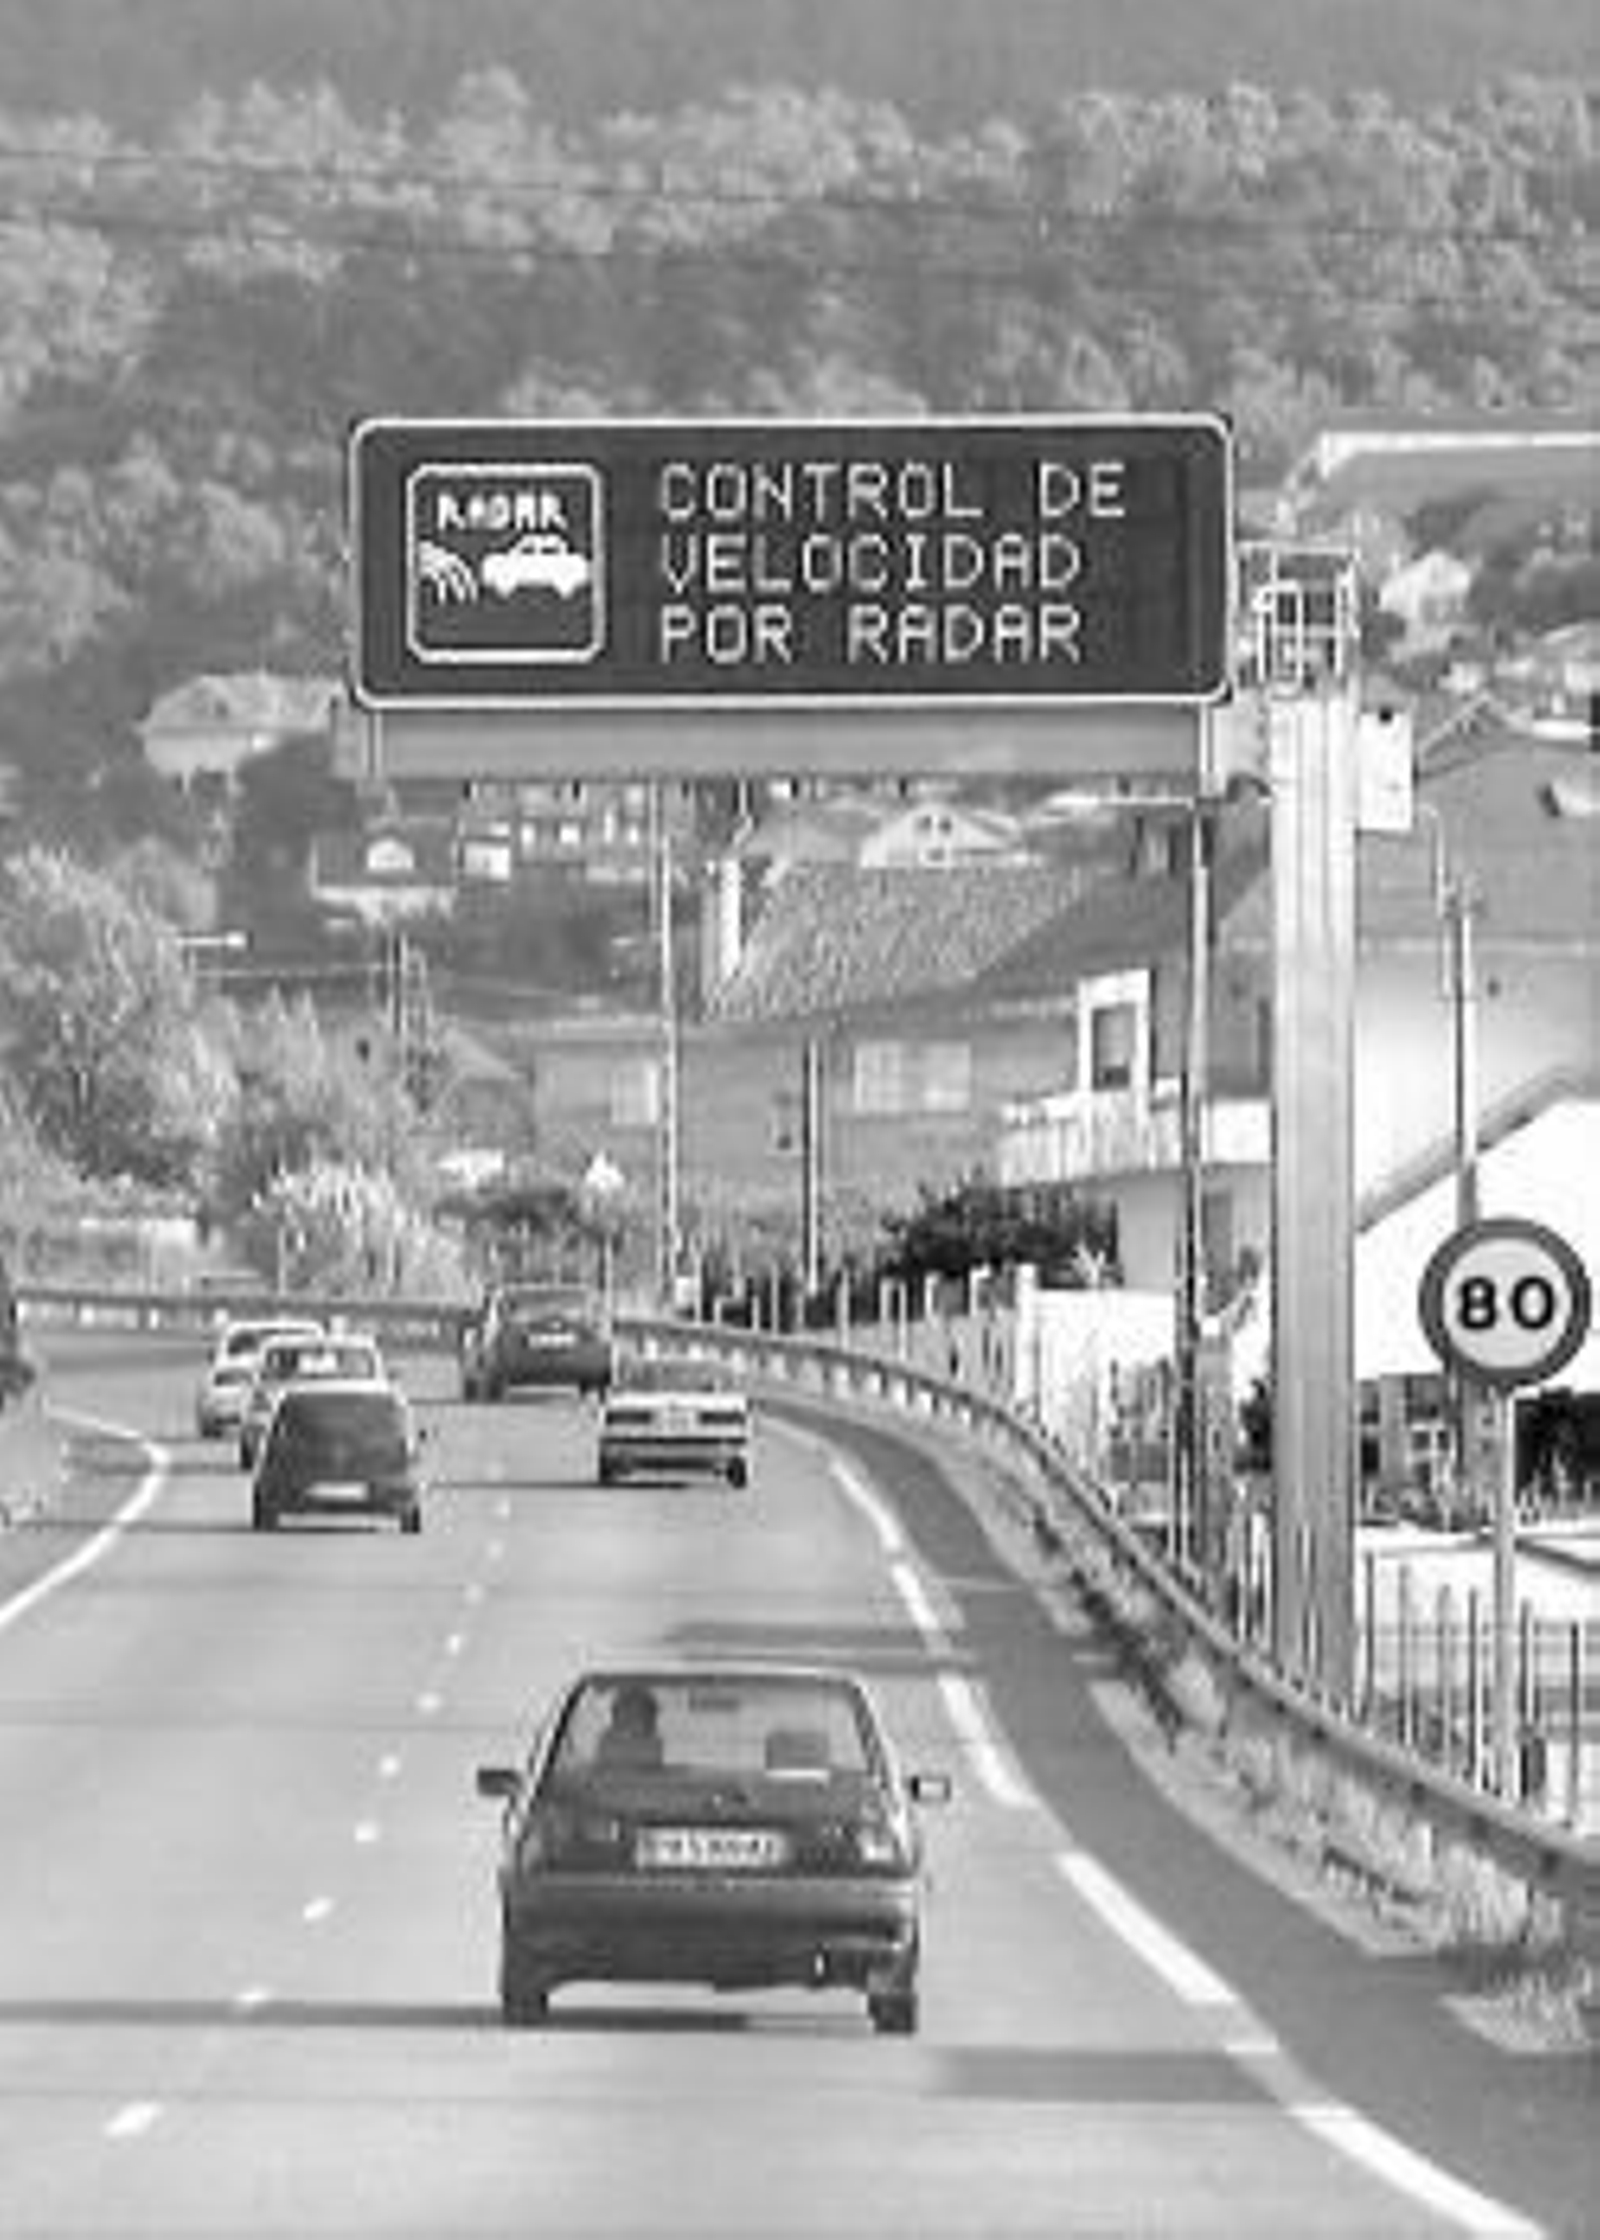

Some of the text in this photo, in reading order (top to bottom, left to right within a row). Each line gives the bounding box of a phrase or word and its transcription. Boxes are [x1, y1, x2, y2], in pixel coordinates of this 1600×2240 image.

[436, 493, 568, 531] RADAR
[659, 461, 1126, 520] CONTROL DE
[660, 534, 1081, 593] VELOCIDAD
[660, 605, 1081, 663] POR RADAR
[1459, 1276, 1555, 1331] 80
